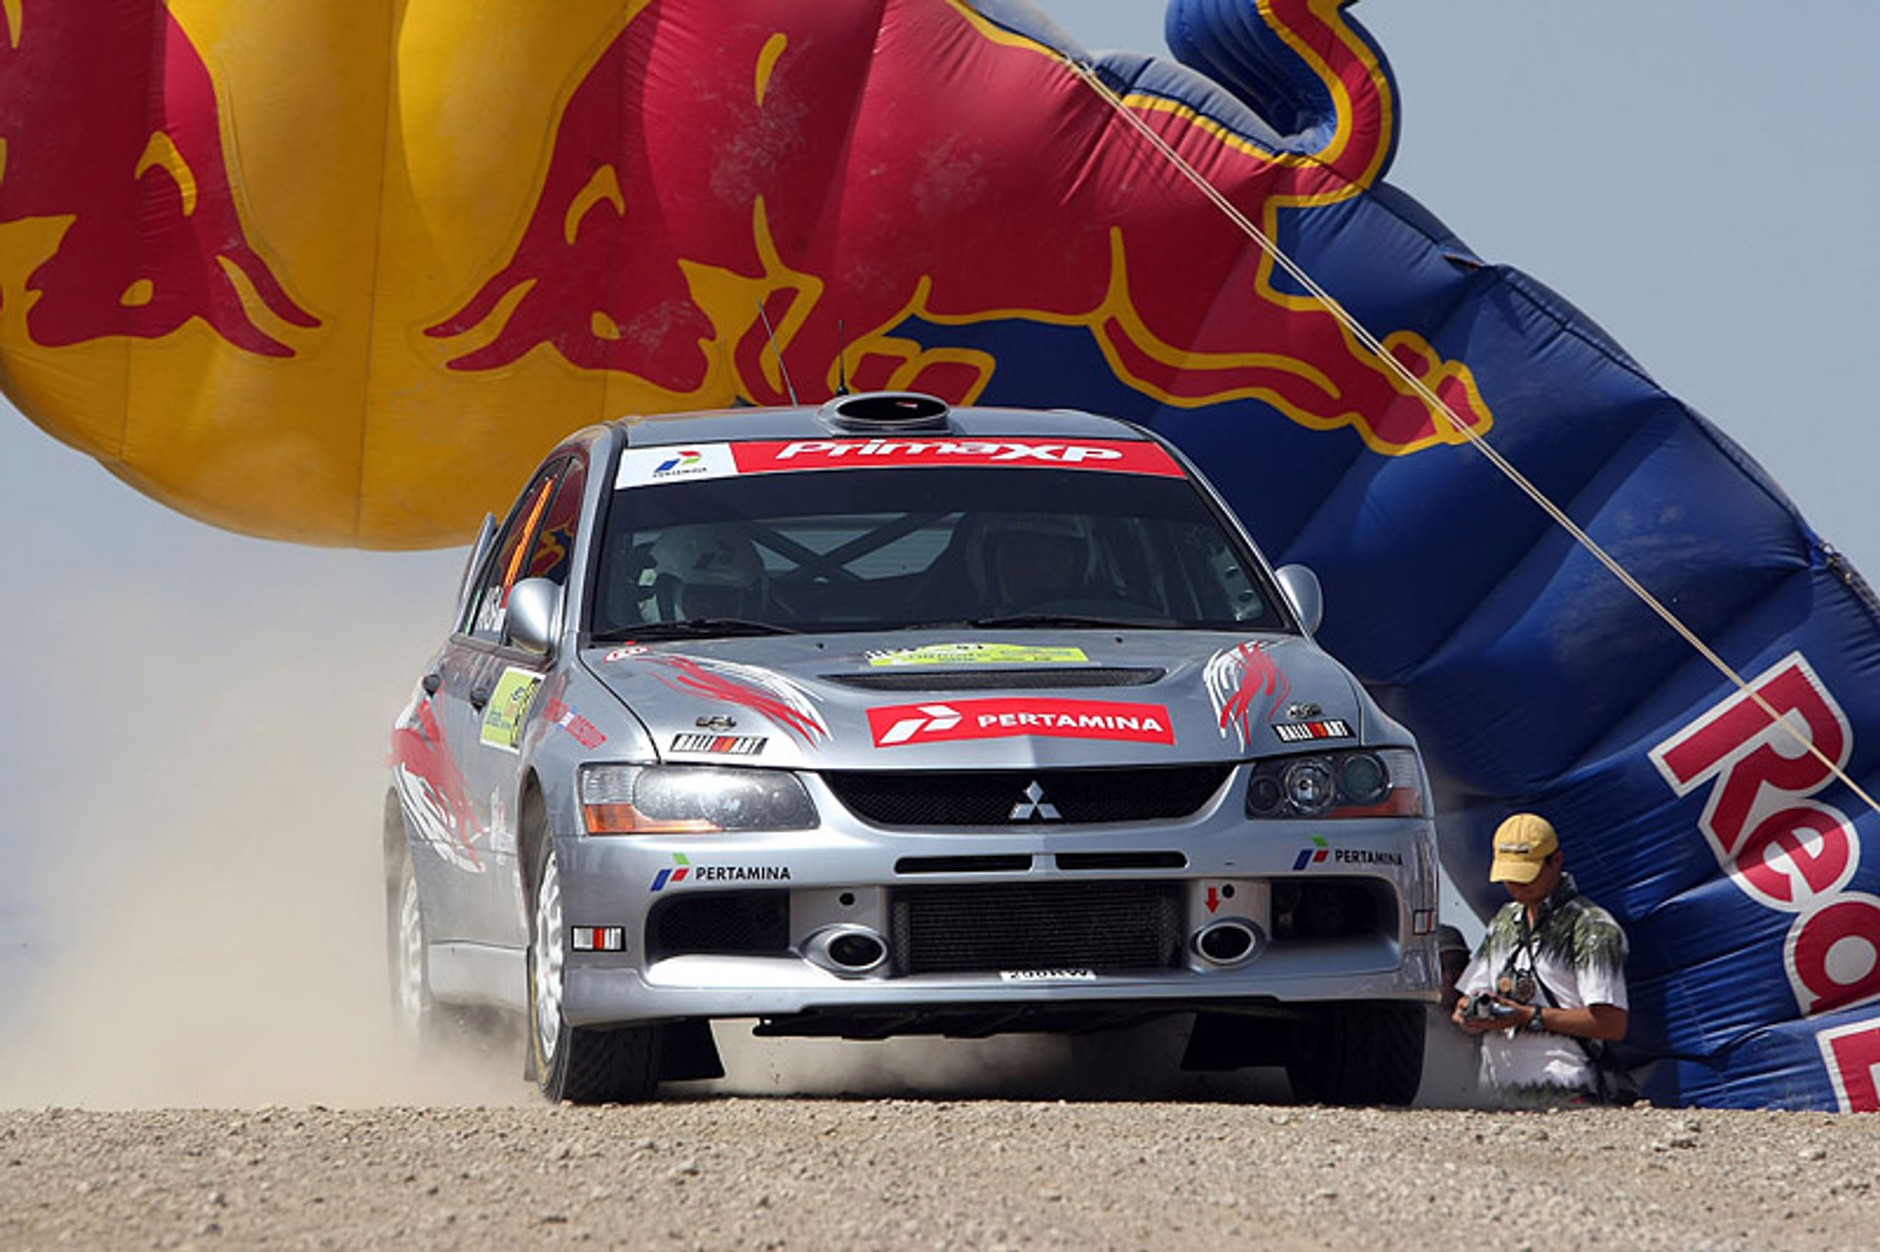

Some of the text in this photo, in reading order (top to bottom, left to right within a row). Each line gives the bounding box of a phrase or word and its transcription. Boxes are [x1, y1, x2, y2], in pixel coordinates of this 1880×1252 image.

[776, 439, 1123, 462] PrimaXP
[977, 713, 1165, 732] PERTAMINA
[1334, 848, 1404, 866] PERTAMINA
[695, 867, 791, 880] PERTAMINA
